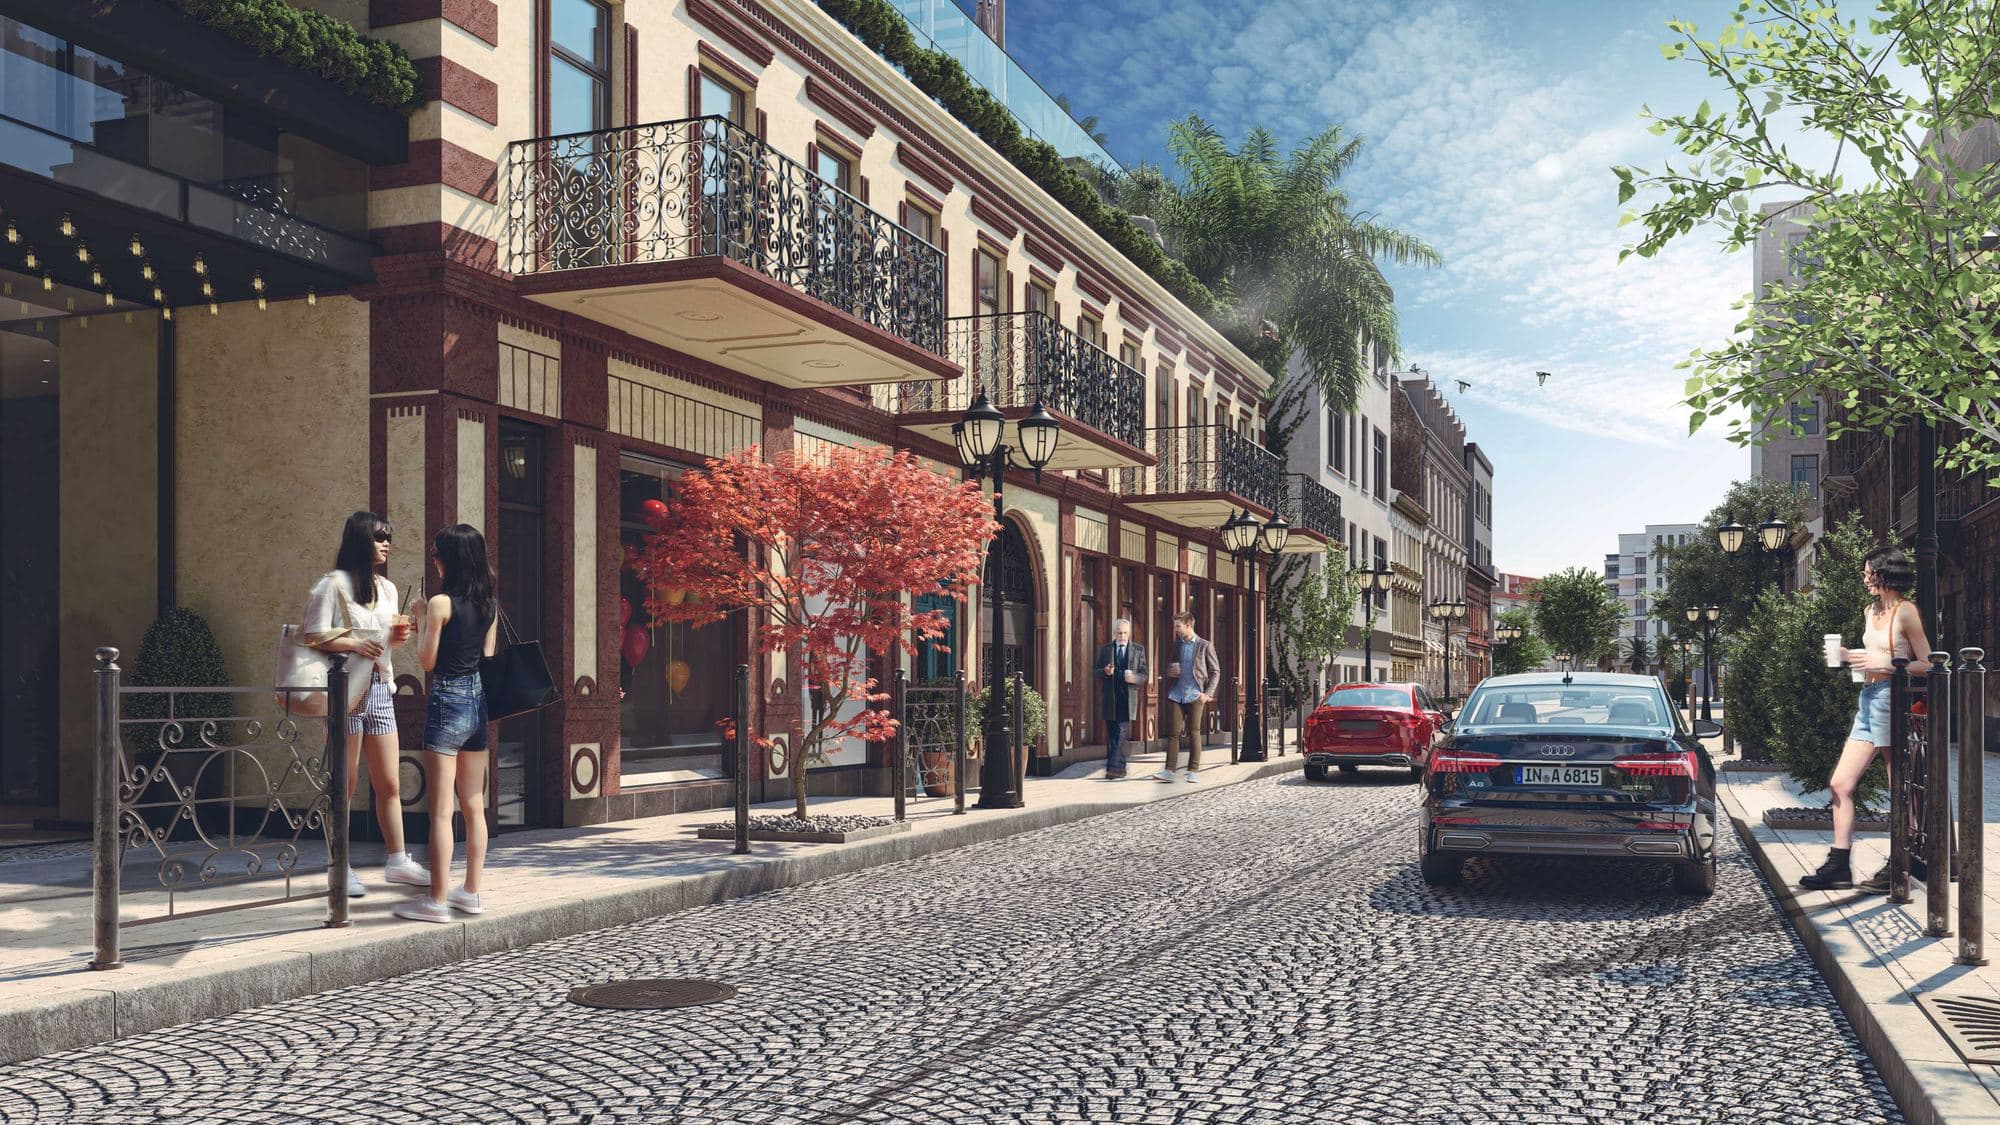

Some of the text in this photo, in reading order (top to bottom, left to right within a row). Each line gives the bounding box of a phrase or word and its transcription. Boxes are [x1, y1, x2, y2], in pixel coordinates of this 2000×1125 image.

[1524, 768, 1542, 782] IN
[1551, 769, 1560, 783] A
[1564, 769, 1599, 784] 6815
[1469, 780, 1484, 788] A6
